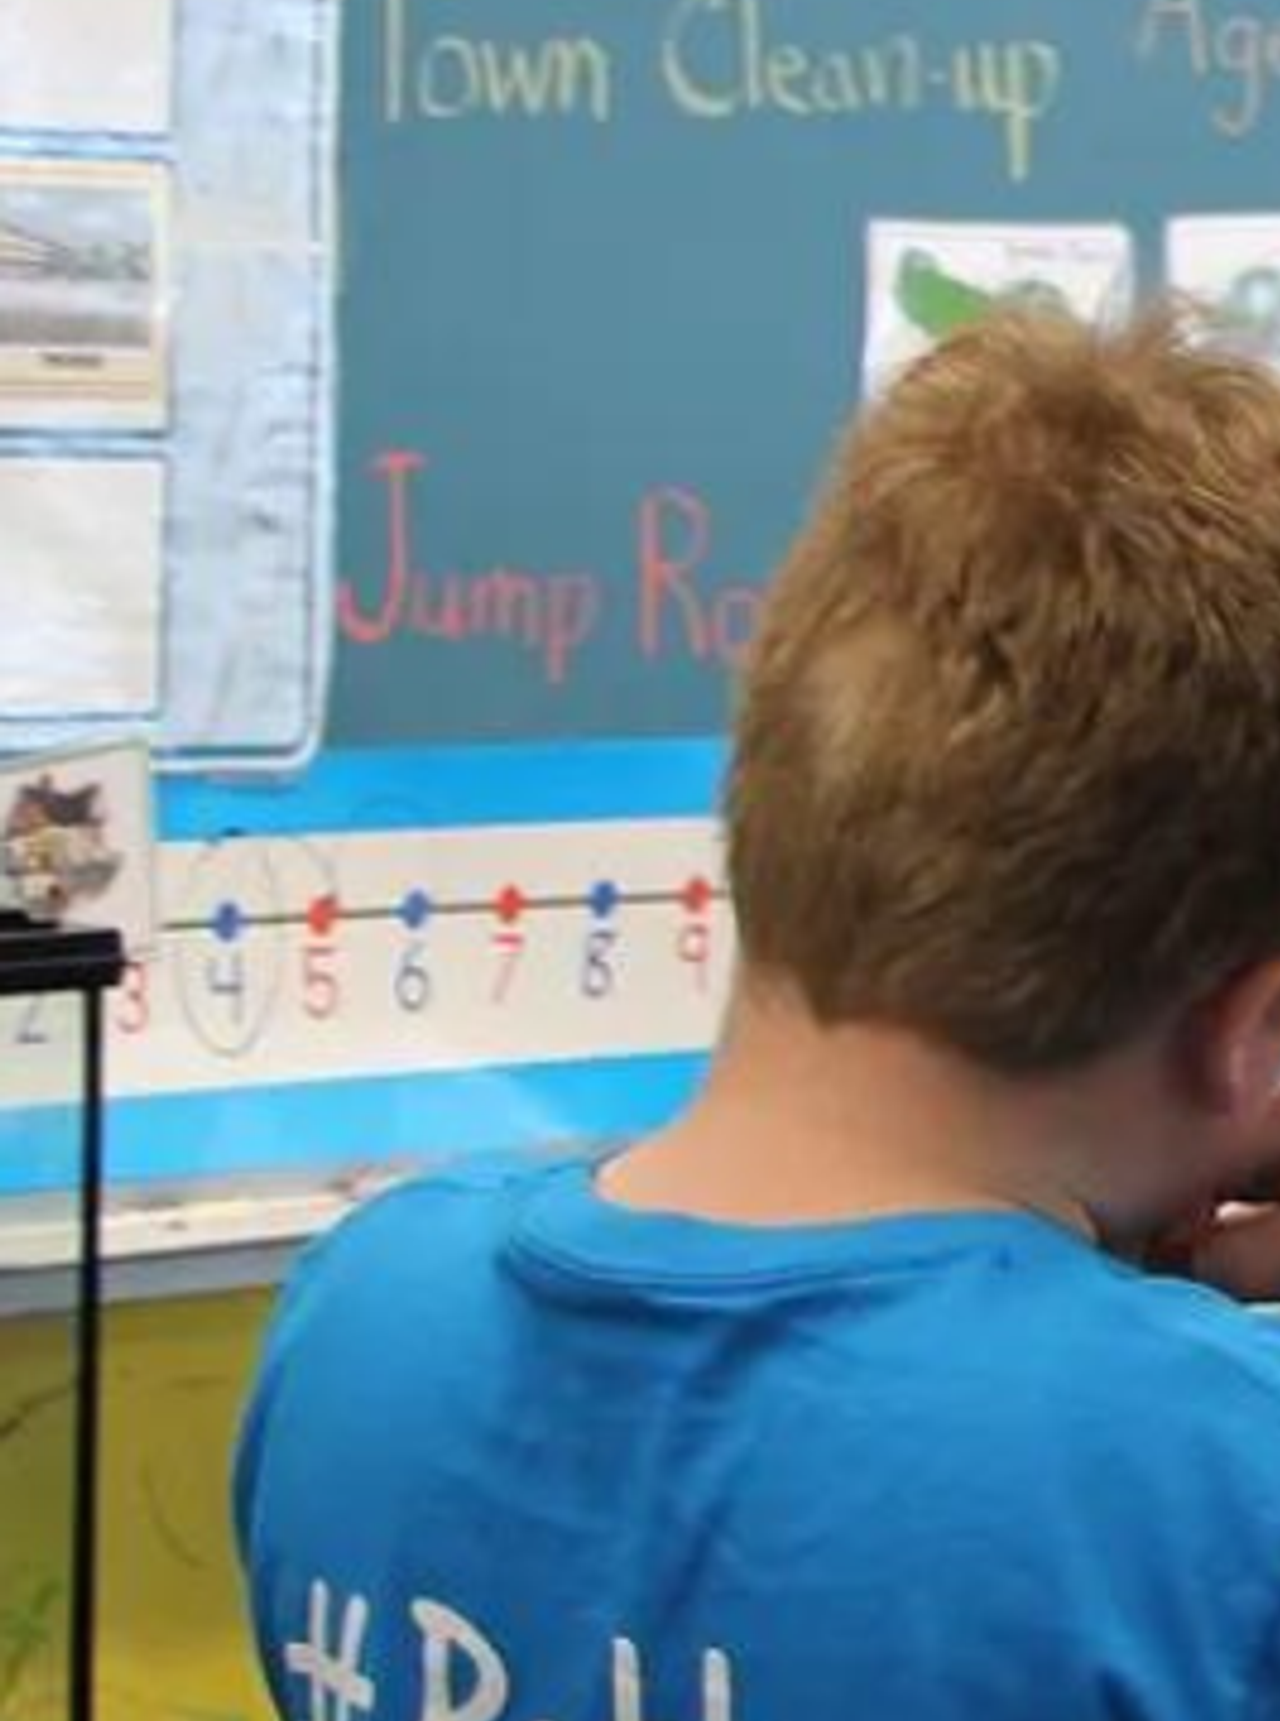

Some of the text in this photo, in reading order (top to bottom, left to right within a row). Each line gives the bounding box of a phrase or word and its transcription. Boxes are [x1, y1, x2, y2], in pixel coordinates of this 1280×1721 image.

[335, 449, 600, 683] Jump
[209, 948, 244, 1024] 4
[302, 946, 339, 1020] 5
[394, 940, 432, 1012] 6
[490, 933, 524, 1005] 7
[581, 928, 613, 999] 8
[678, 923, 711, 997] 9
